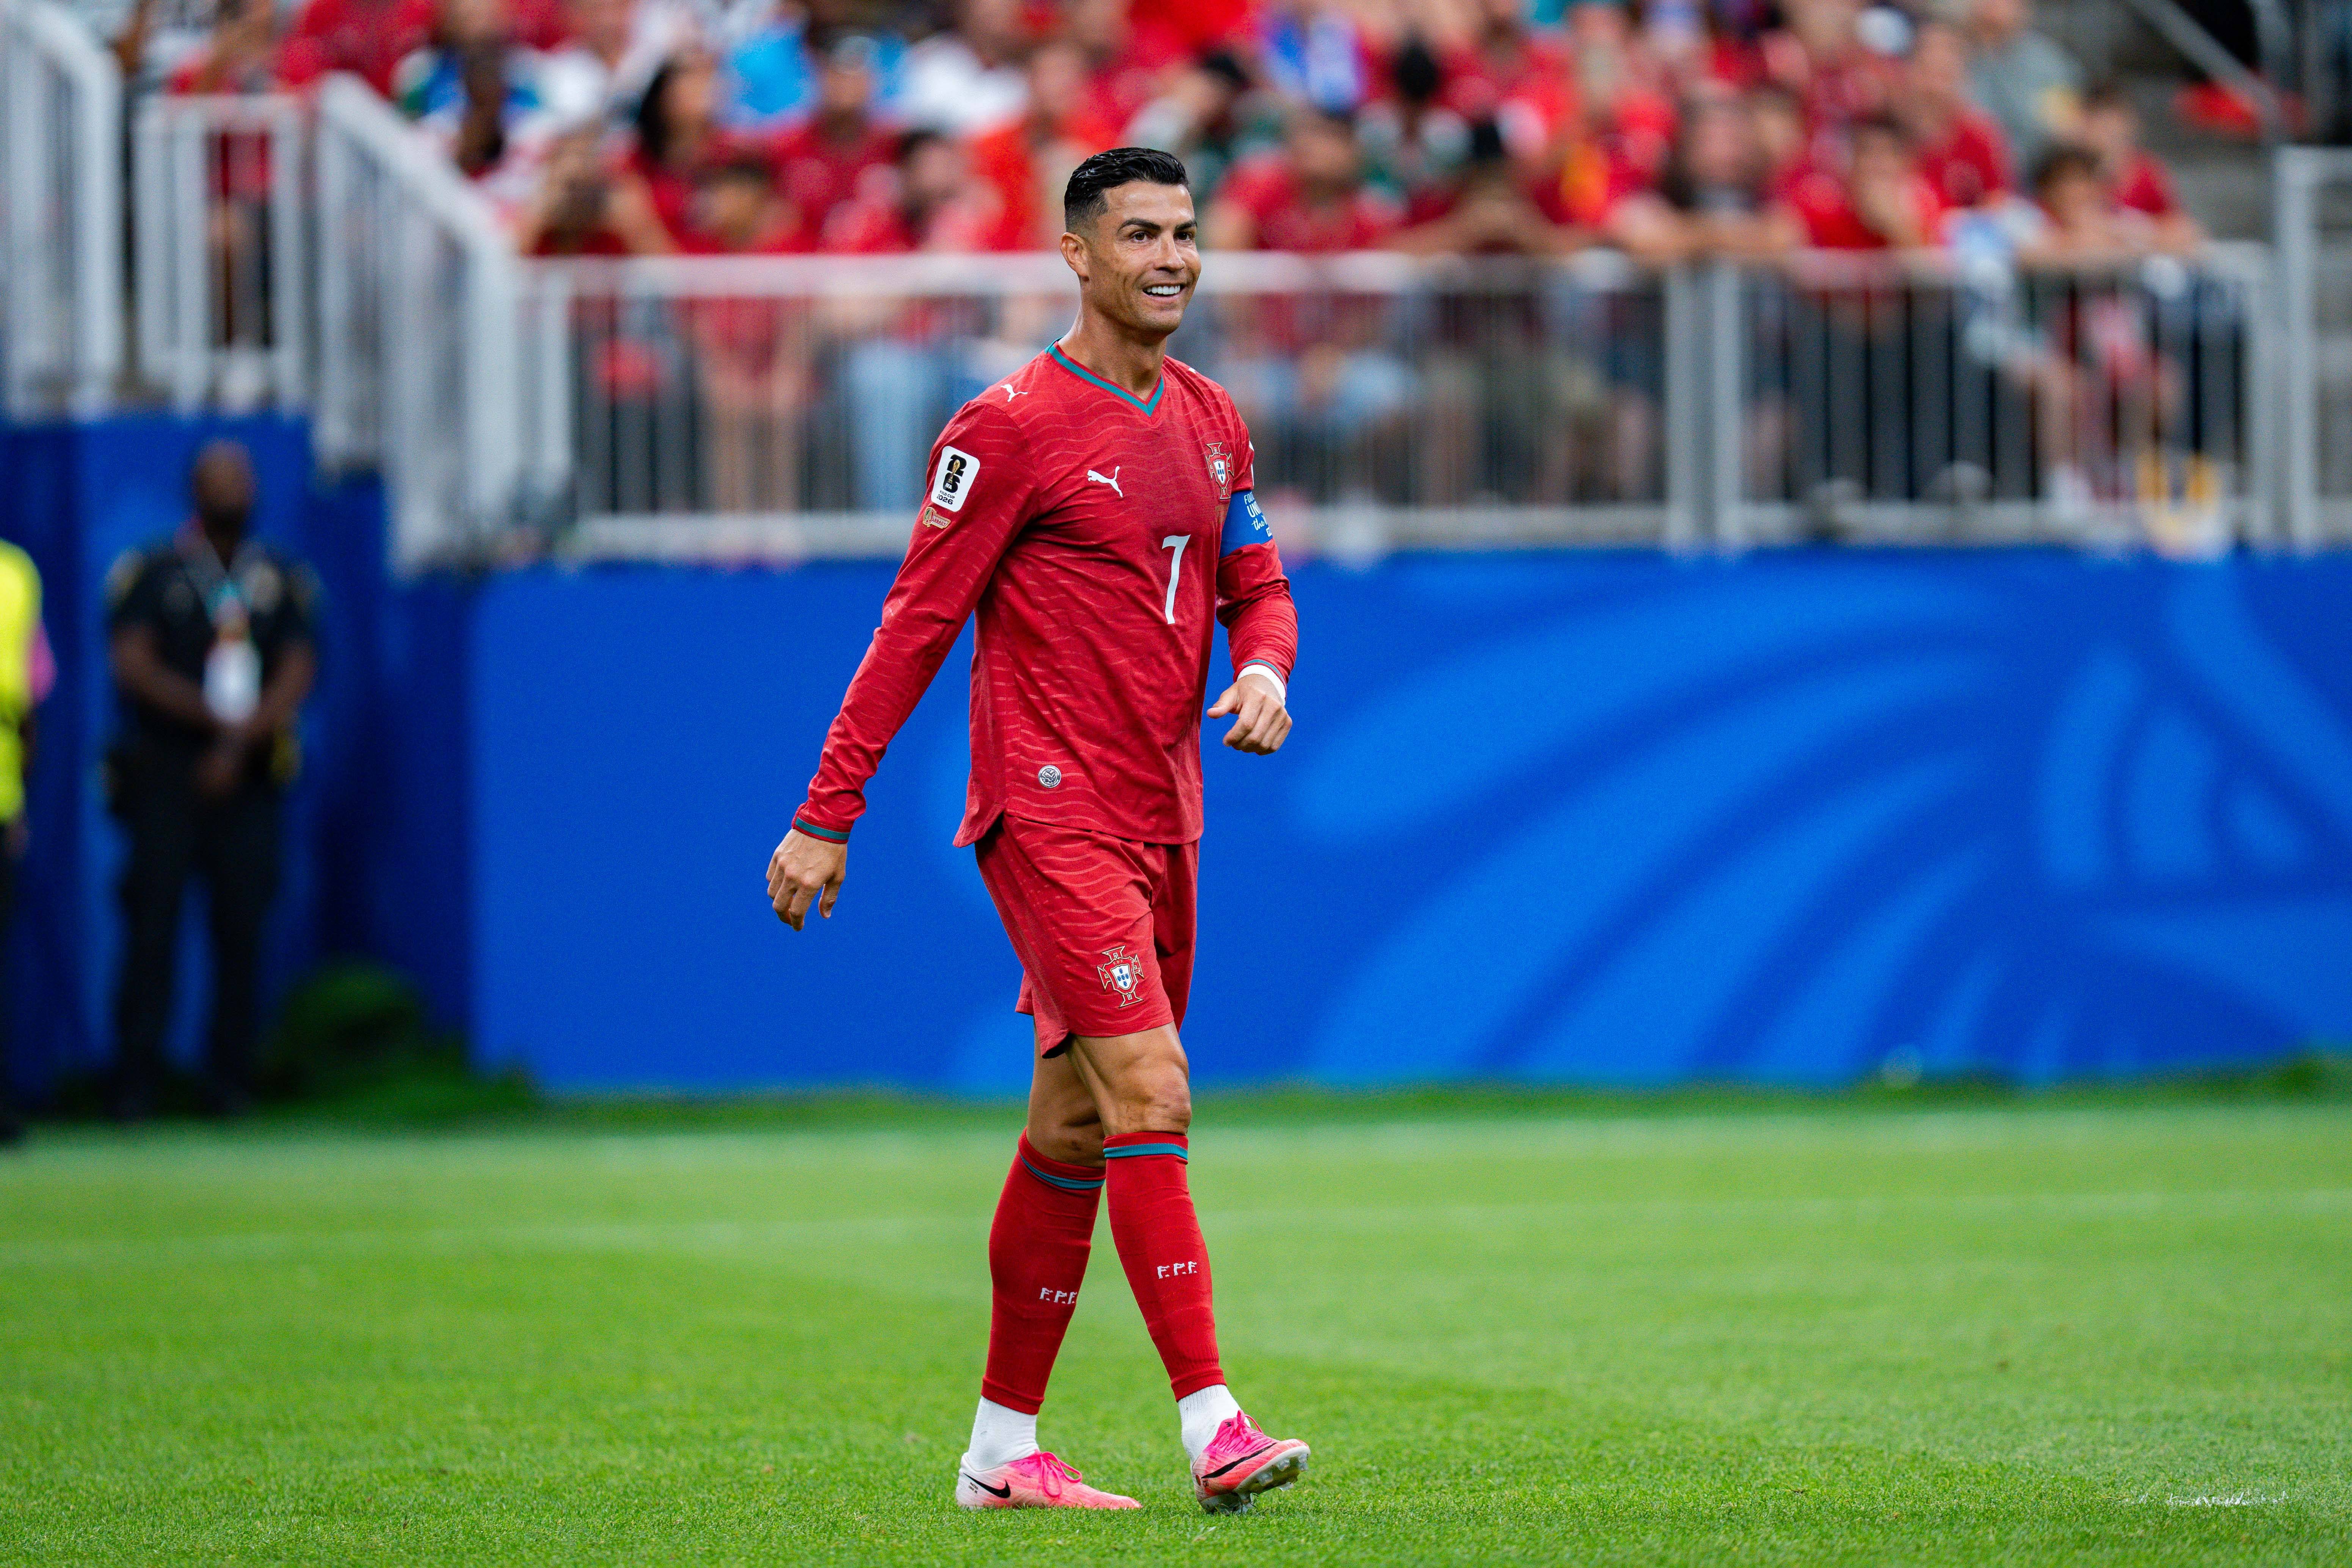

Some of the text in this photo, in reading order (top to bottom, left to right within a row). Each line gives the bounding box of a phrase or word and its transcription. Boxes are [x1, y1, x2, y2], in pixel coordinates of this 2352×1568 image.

[936, 494, 953, 505] 2026
[1251, 518, 1265, 531] the
[1162, 534, 1191, 624] 7
[1157, 1261, 1197, 1279] F.P.F.
[1039, 1287, 1077, 1305] F.P.F.
